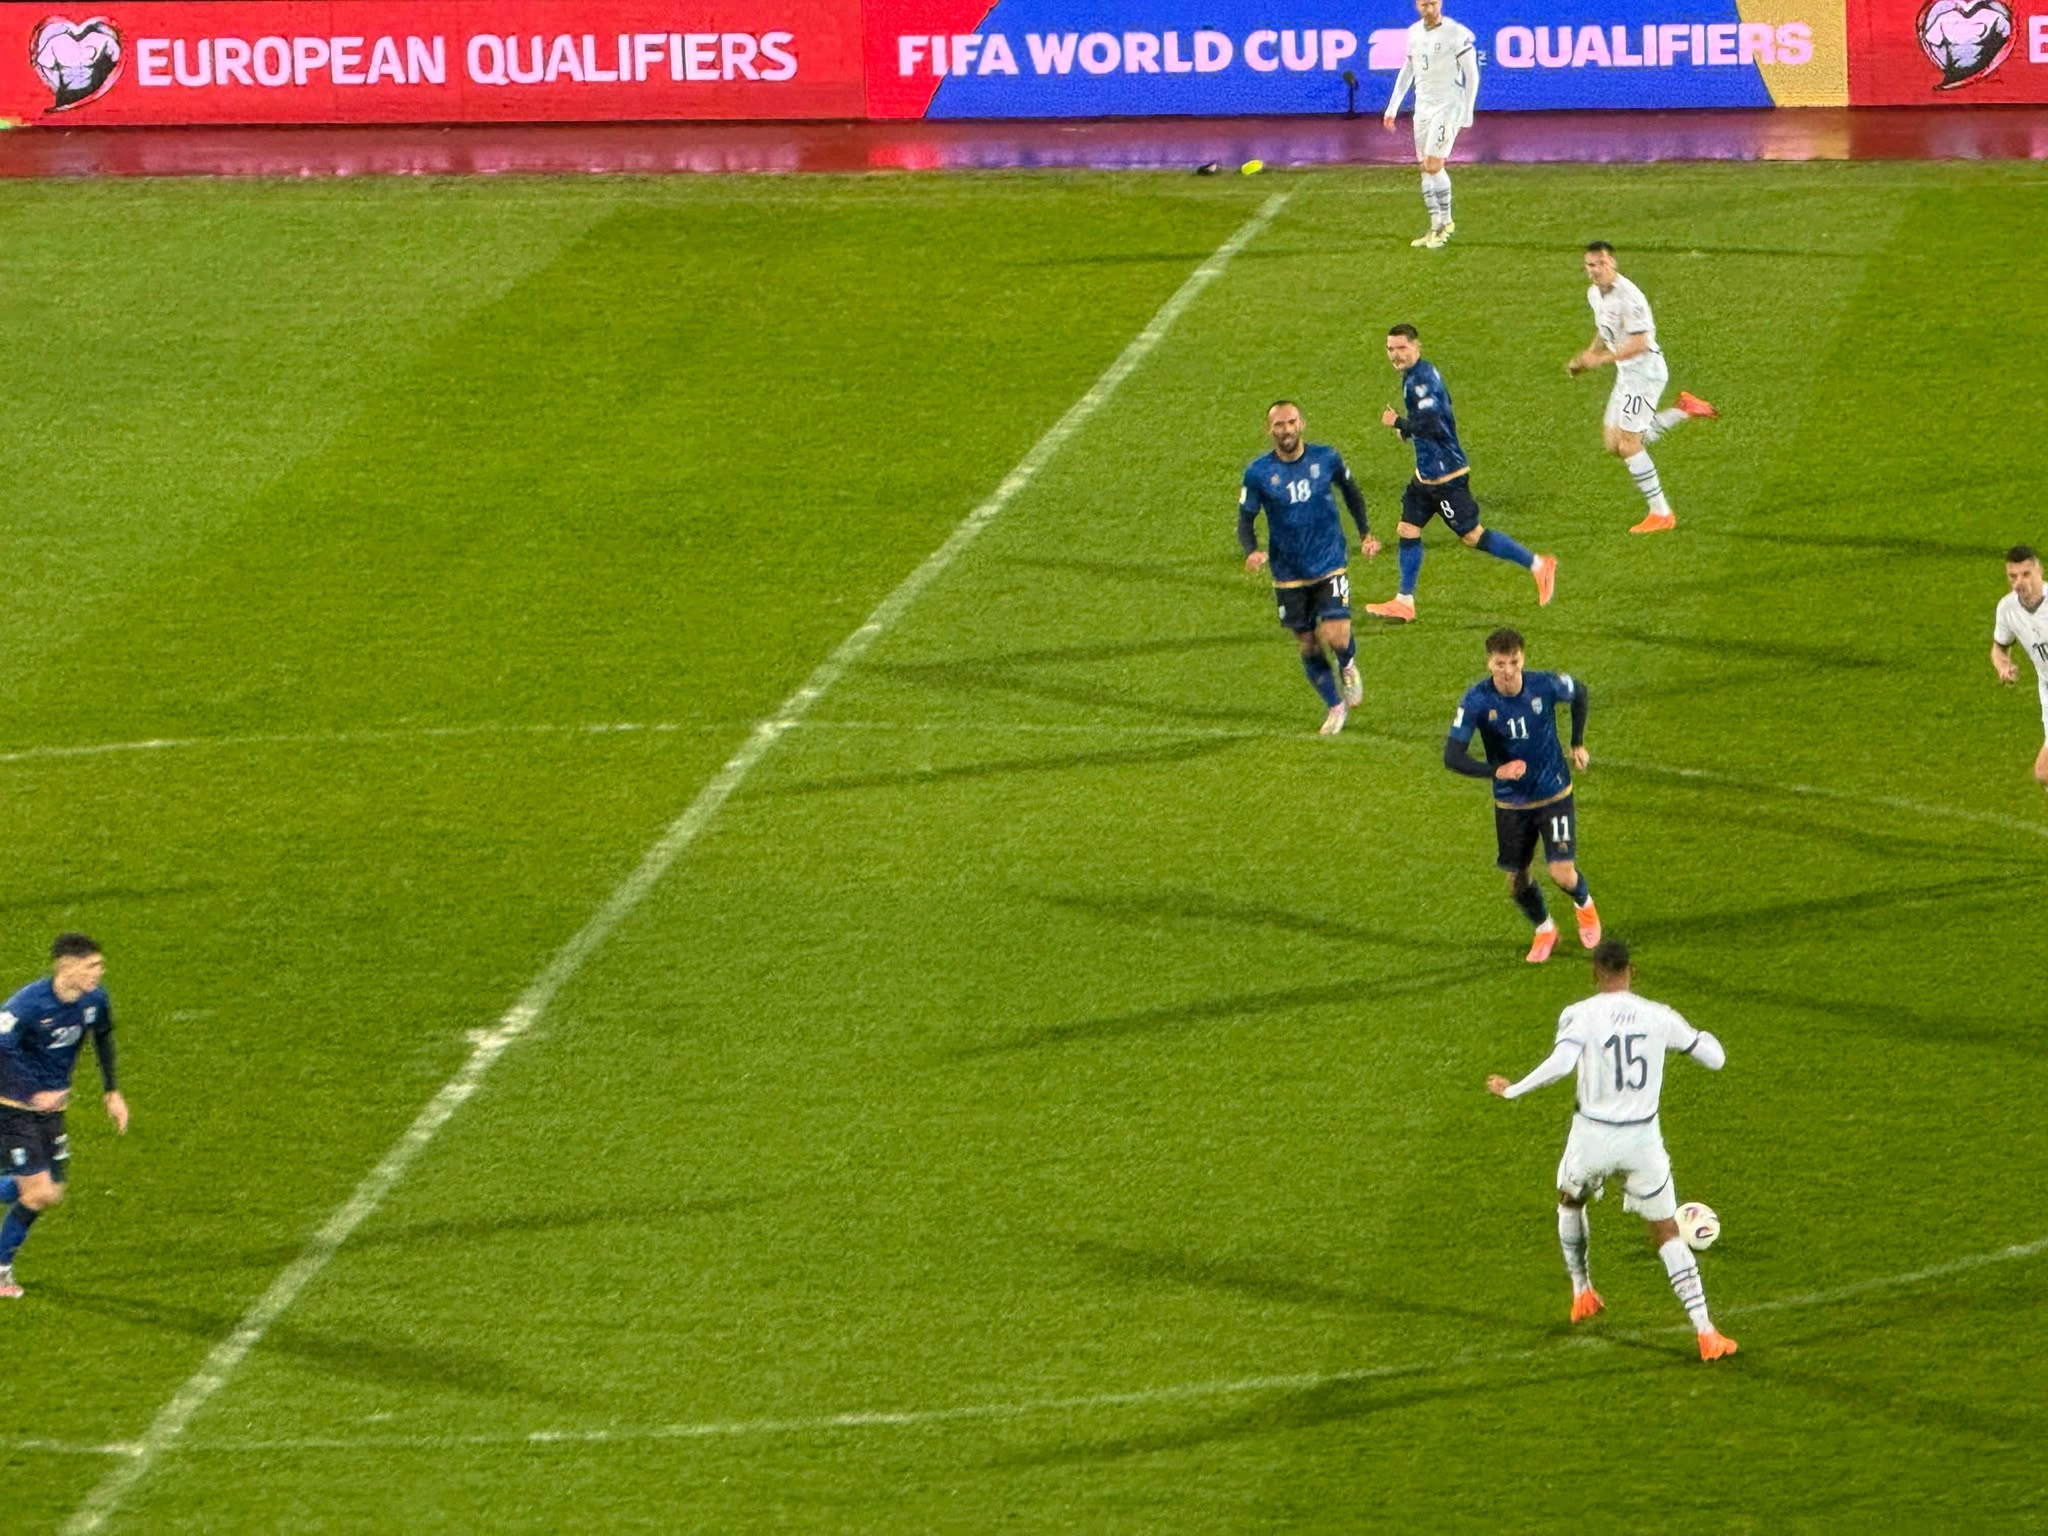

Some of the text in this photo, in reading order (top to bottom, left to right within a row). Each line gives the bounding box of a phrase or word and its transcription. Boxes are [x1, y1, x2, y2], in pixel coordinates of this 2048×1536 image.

[136, 31, 798, 87] EUROPEAN QUALIFIERS
[899, 33, 1018, 76] FIFA
[1026, 31, 1234, 74] WORLD
[1243, 29, 1358, 71] CUP
[1495, 21, 1813, 68] QUALIFIERS
[1421, 53, 1429, 71] 3
[1437, 125, 1446, 143] 3
[1622, 393, 1642, 415] 20
[1286, 478, 1312, 504] 18
[1439, 499, 1455, 519] 8
[1506, 715, 1530, 740] 11
[1551, 815, 1571, 842] 11
[1604, 1033, 1648, 1092] 15
